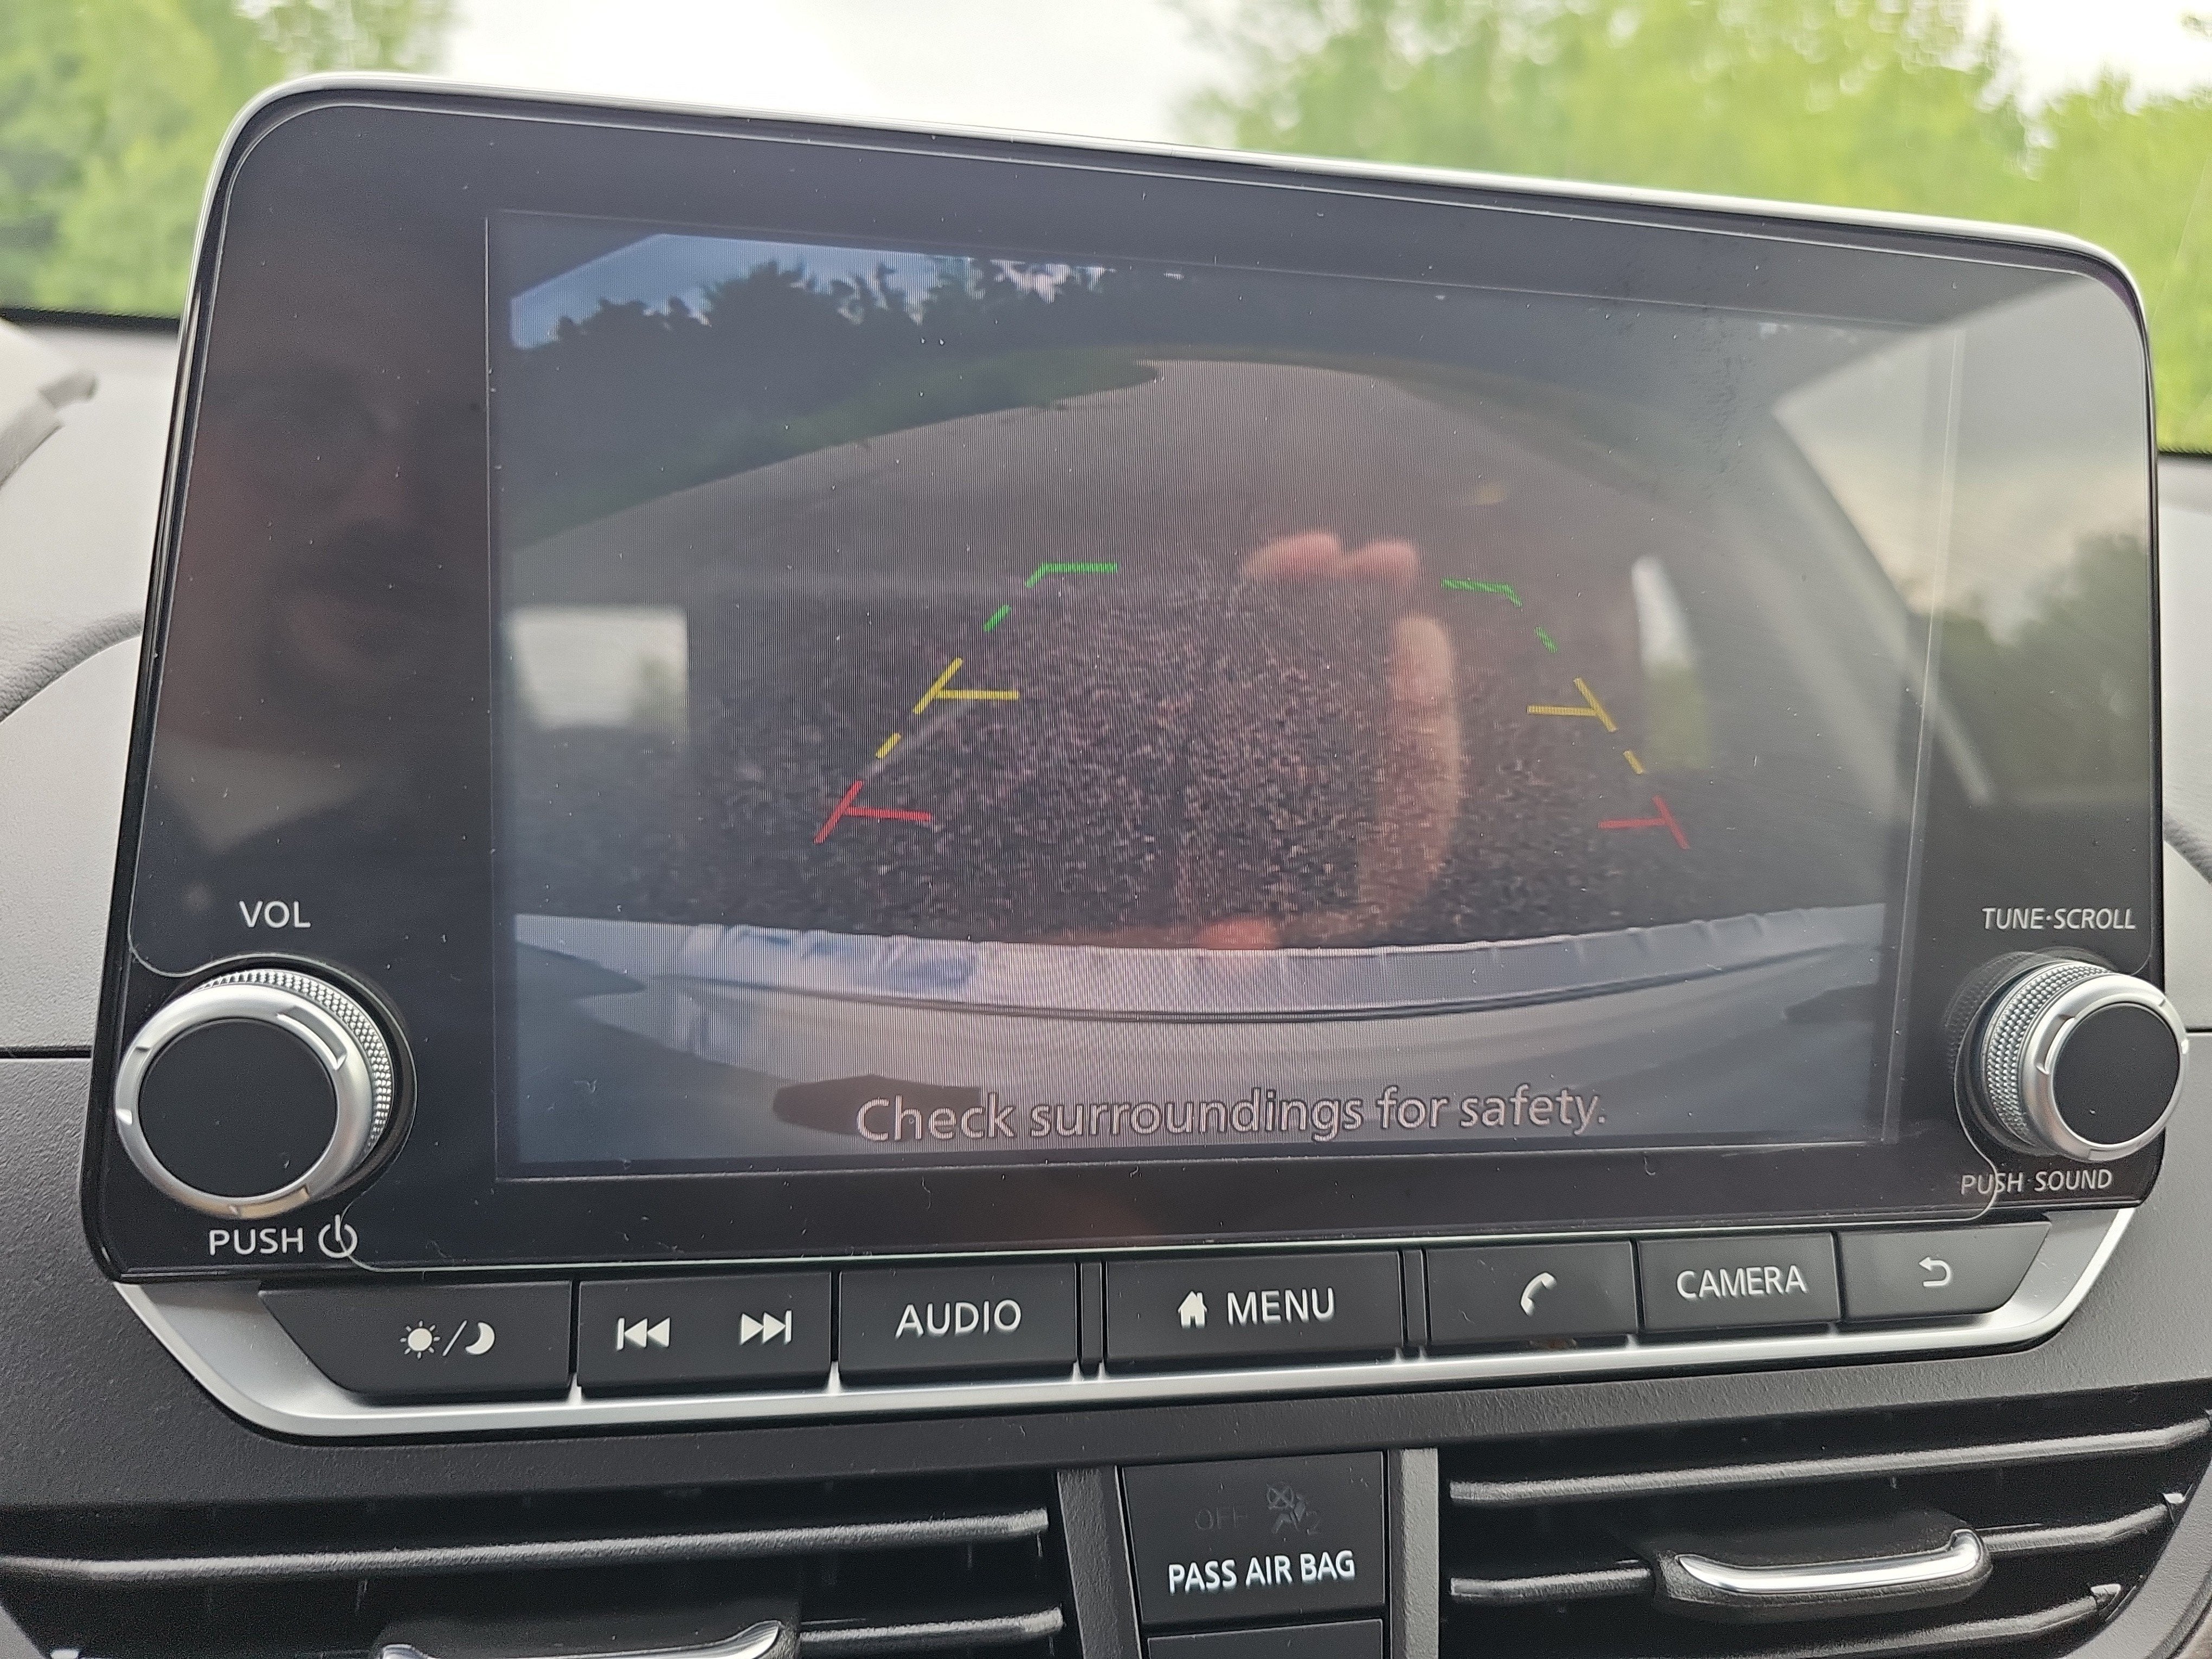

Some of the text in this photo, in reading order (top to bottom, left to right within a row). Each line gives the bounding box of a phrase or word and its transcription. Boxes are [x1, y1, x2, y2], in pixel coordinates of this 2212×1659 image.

[239, 900, 311, 928] VOL
[856, 1084, 1608, 1142] Check surroundings for safety.
[1960, 1169, 2112, 1195] PUSH SOUND
[208, 1227, 304, 1256] PUSH
[1676, 1264, 1807, 1300] CAMERA
[895, 1300, 1021, 1338] AUDIO
[1227, 1287, 1334, 1325] MENU
[1168, 1549, 1355, 1594] PASS AIR BAG
